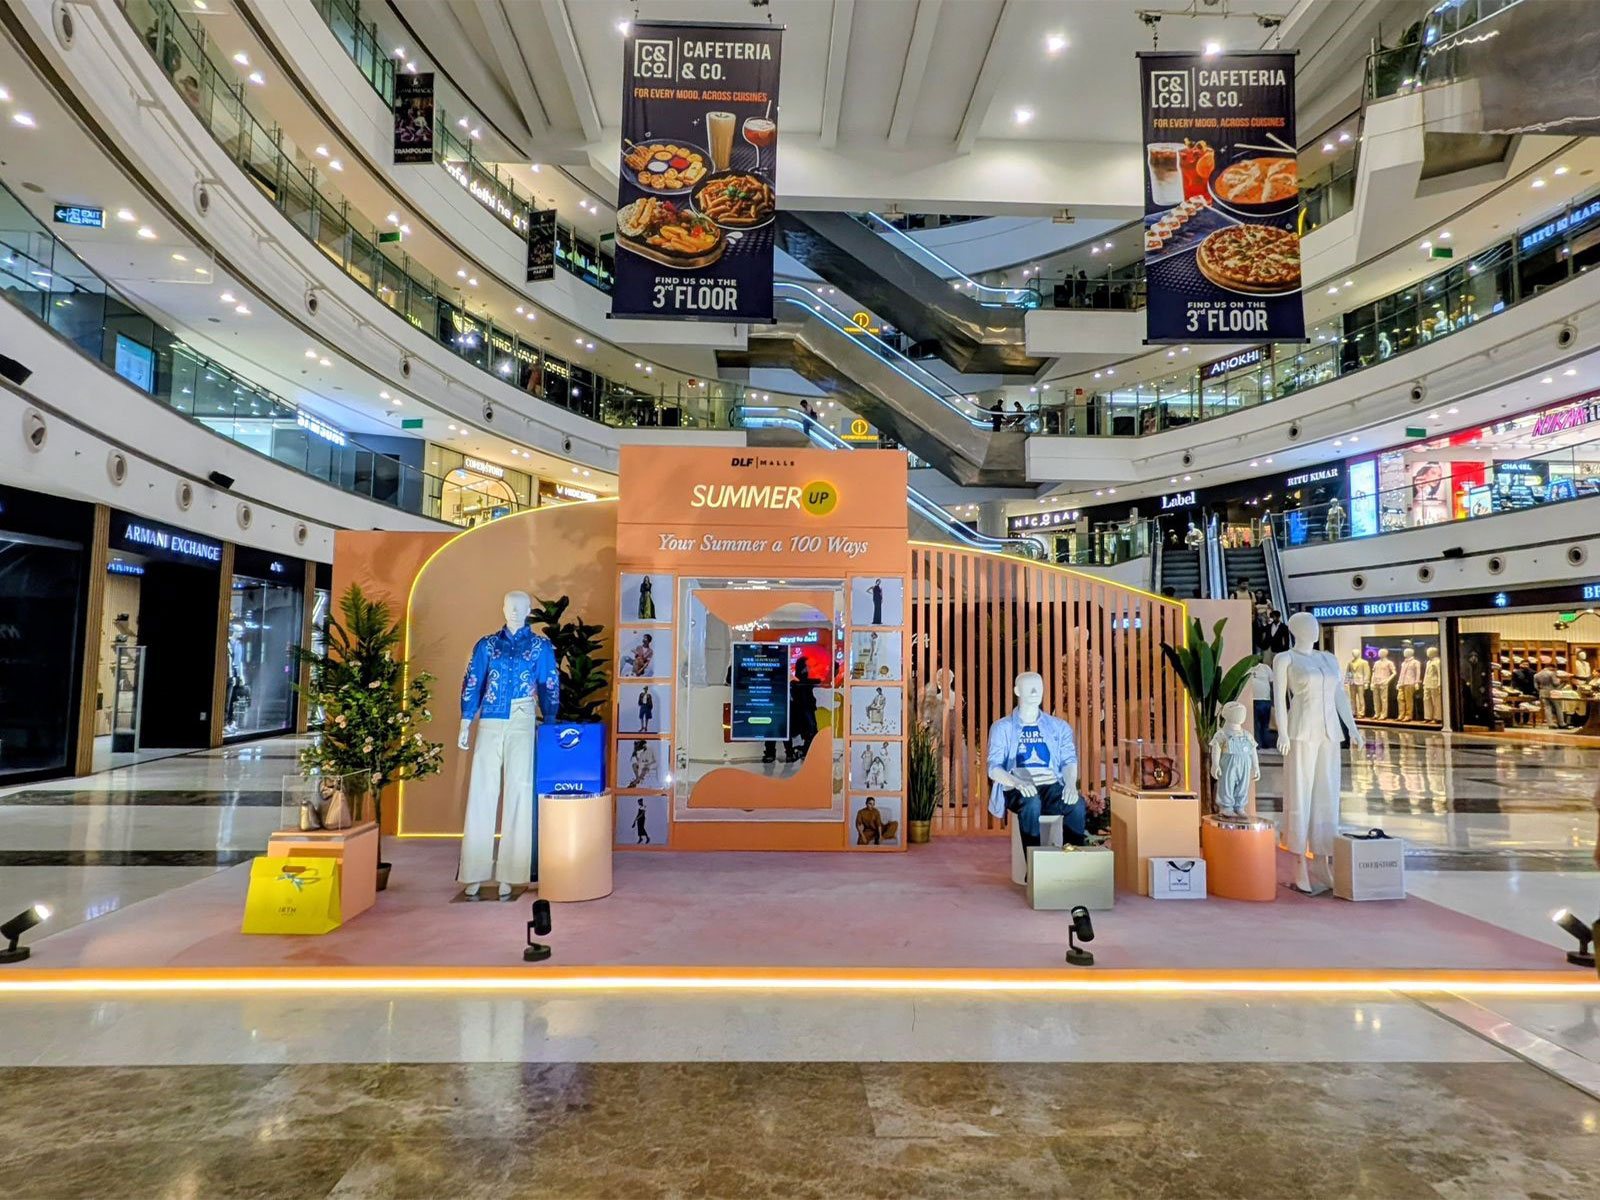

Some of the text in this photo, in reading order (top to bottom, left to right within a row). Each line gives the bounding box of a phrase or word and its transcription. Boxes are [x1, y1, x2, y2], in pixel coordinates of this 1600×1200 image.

[642, 45, 667, 61] C&
[683, 41, 772, 60] CAFETERIA
[681, 63, 726, 80] & CO.
[1198, 69, 1287, 88] CAFETERIA
[1157, 76, 1184, 92] C&
[634, 87, 768, 103] FOR EVERY MOOD, ACROSS CUISINES
[1198, 91, 1243, 107] & CO.
[1153, 118, 1168, 128] FOR
[1169, 118, 1194, 129] EVERY
[1219, 117, 1249, 128] ACROSS
[1250, 116, 1286, 128] CUISINES
[469, 179, 497, 209] delhi
[81, 209, 101, 219] EXIT
[1522, 223, 1556, 249] RITU
[655, 276, 737, 287] FIND US ON THE
[652, 284, 738, 311] 3rd FLOOR
[1187, 301, 1266, 309] FIND US ON THE
[1186, 308, 1269, 332] 3rd FLOOR
[1210, 349, 1260, 375] ANOKHI
[731, 458, 754, 467] DLF
[1287, 474, 1309, 487] RITU
[690, 484, 829, 510] SUMMER UP
[1161, 491, 1196, 509] Label
[124, 523, 221, 562] ARMANI EXCHANGE
[658, 534, 869, 559] Your Summer a 100 Ways
[1313, 600, 1430, 618] BROOKS BROTHERS
